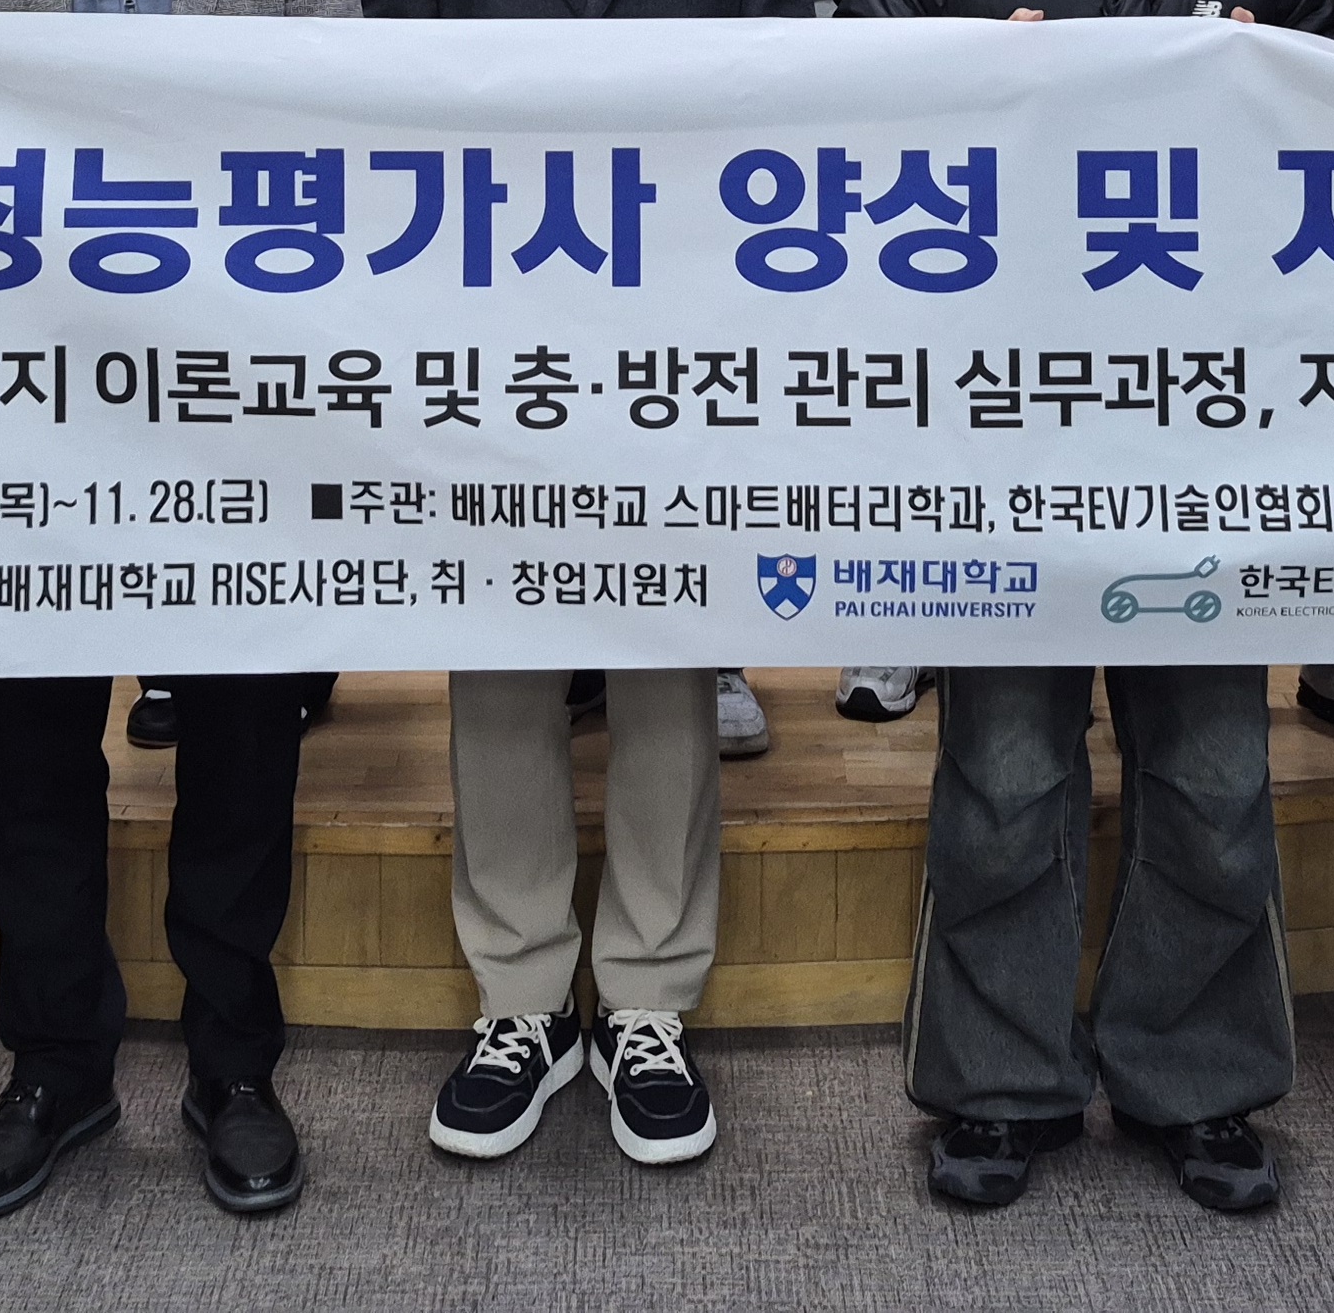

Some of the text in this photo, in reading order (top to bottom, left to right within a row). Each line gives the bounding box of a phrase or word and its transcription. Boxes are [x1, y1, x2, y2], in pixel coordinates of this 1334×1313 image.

[719, 147, 997, 293] 양성
[1077, 148, 1204, 291] 및
[96, 348, 391, 428] 이론교육
[416, 348, 481, 427] 및
[505, 346, 759, 429] 충·방전
[784, 348, 928, 427] 관리
[955, 348, 1273, 428] 실무과정,
[350, 481, 1332, 533] 주관: 배재대학교 스마트배터리학과, 한국EV기술인협회
[212, 559, 416, 606] RISE사업단,
[432, 560, 464, 604] 취
[513, 561, 706, 606] 창업지원처
[834, 560, 1037, 593] 배재대학교
[836, 602, 1035, 617] PAI CHAI UNIVERSITY
[1236, 607, 1277, 617] KOREA
